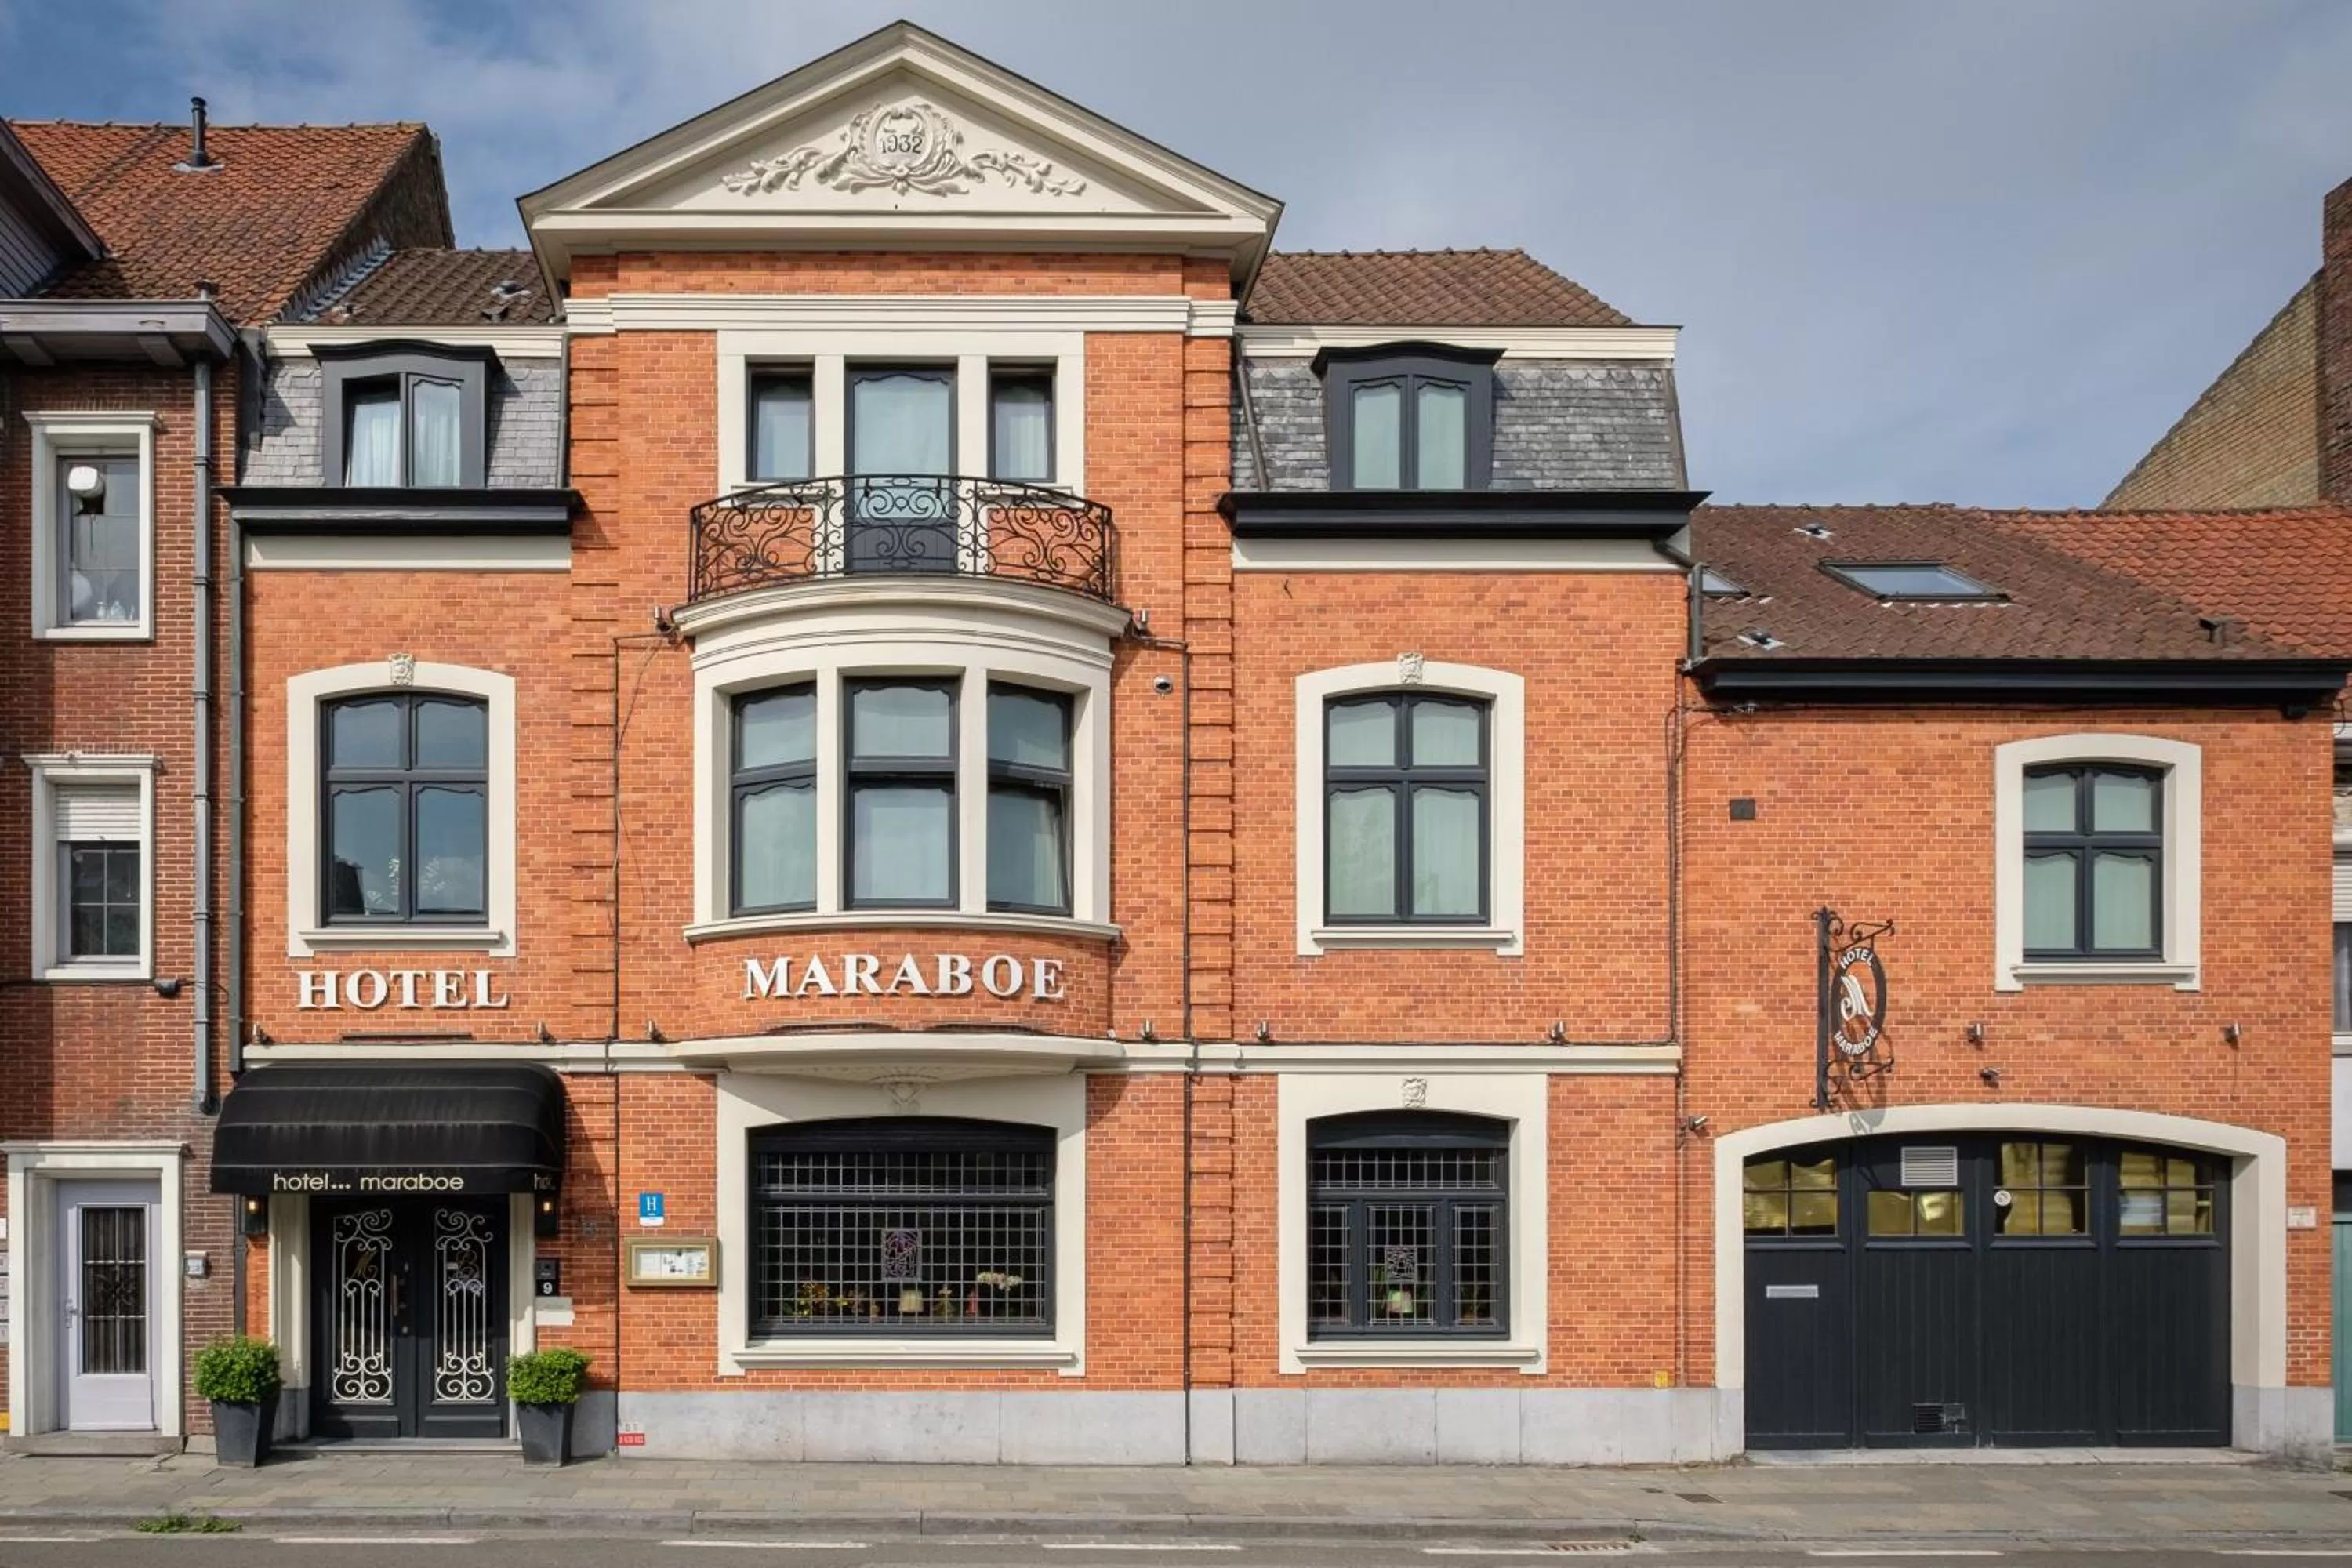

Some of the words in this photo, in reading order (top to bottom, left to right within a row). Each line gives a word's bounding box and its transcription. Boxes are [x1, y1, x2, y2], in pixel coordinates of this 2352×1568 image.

[880, 134, 923, 154] 1932
[1840, 948, 1874, 969] HOTEL
[744, 953, 1065, 1000] MARABOE
[296, 969, 511, 1009] HOTEL
[1834, 1027, 1878, 1056] MARABOE
[360, 1173, 464, 1191] maraboe
[647, 1196, 657, 1211] H
[543, 1282, 553, 1294] 9
